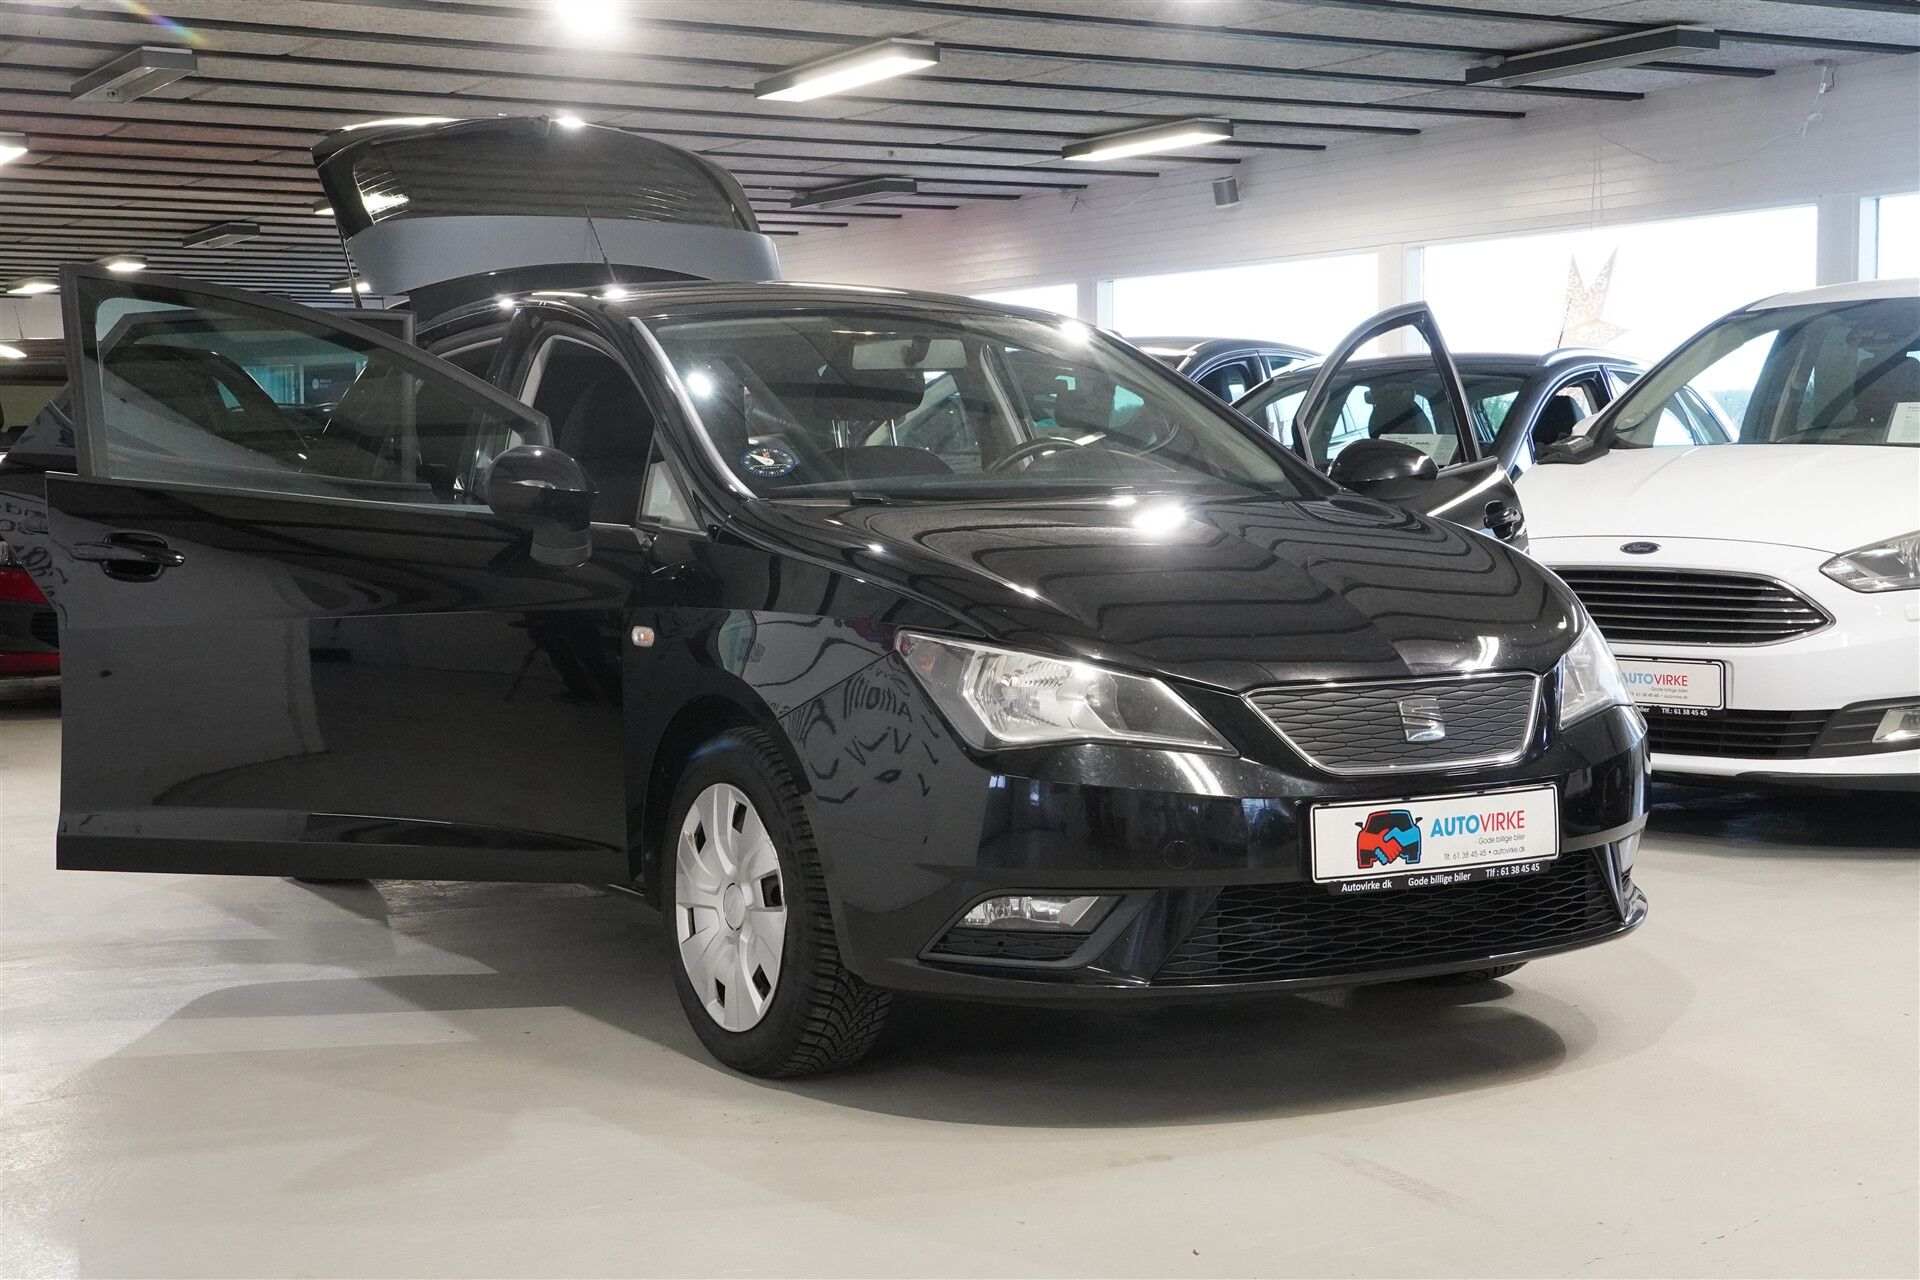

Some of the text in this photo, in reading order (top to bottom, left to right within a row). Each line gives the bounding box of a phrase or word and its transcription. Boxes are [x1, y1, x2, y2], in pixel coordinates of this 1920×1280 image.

[1430, 810, 1525, 838] AUTOVIRKE
[1478, 837, 1495, 845] Gode
[1496, 835, 1512, 844] billige
[1452, 852, 1460, 860] 61
[1462, 851, 1469, 859] 38
[1479, 849, 1487, 857] 45
[1341, 881, 1381, 893] Autovirke
[1382, 880, 1393, 889] dk
[1408, 877, 1429, 886] Gode
[1429, 874, 1453, 886] billige
[1454, 872, 1471, 882] biler
[1500, 866, 1509, 876] 61
[1511, 865, 1520, 874] 38
[1521, 864, 1530, 873] 45
[1531, 863, 1540, 872] 45
